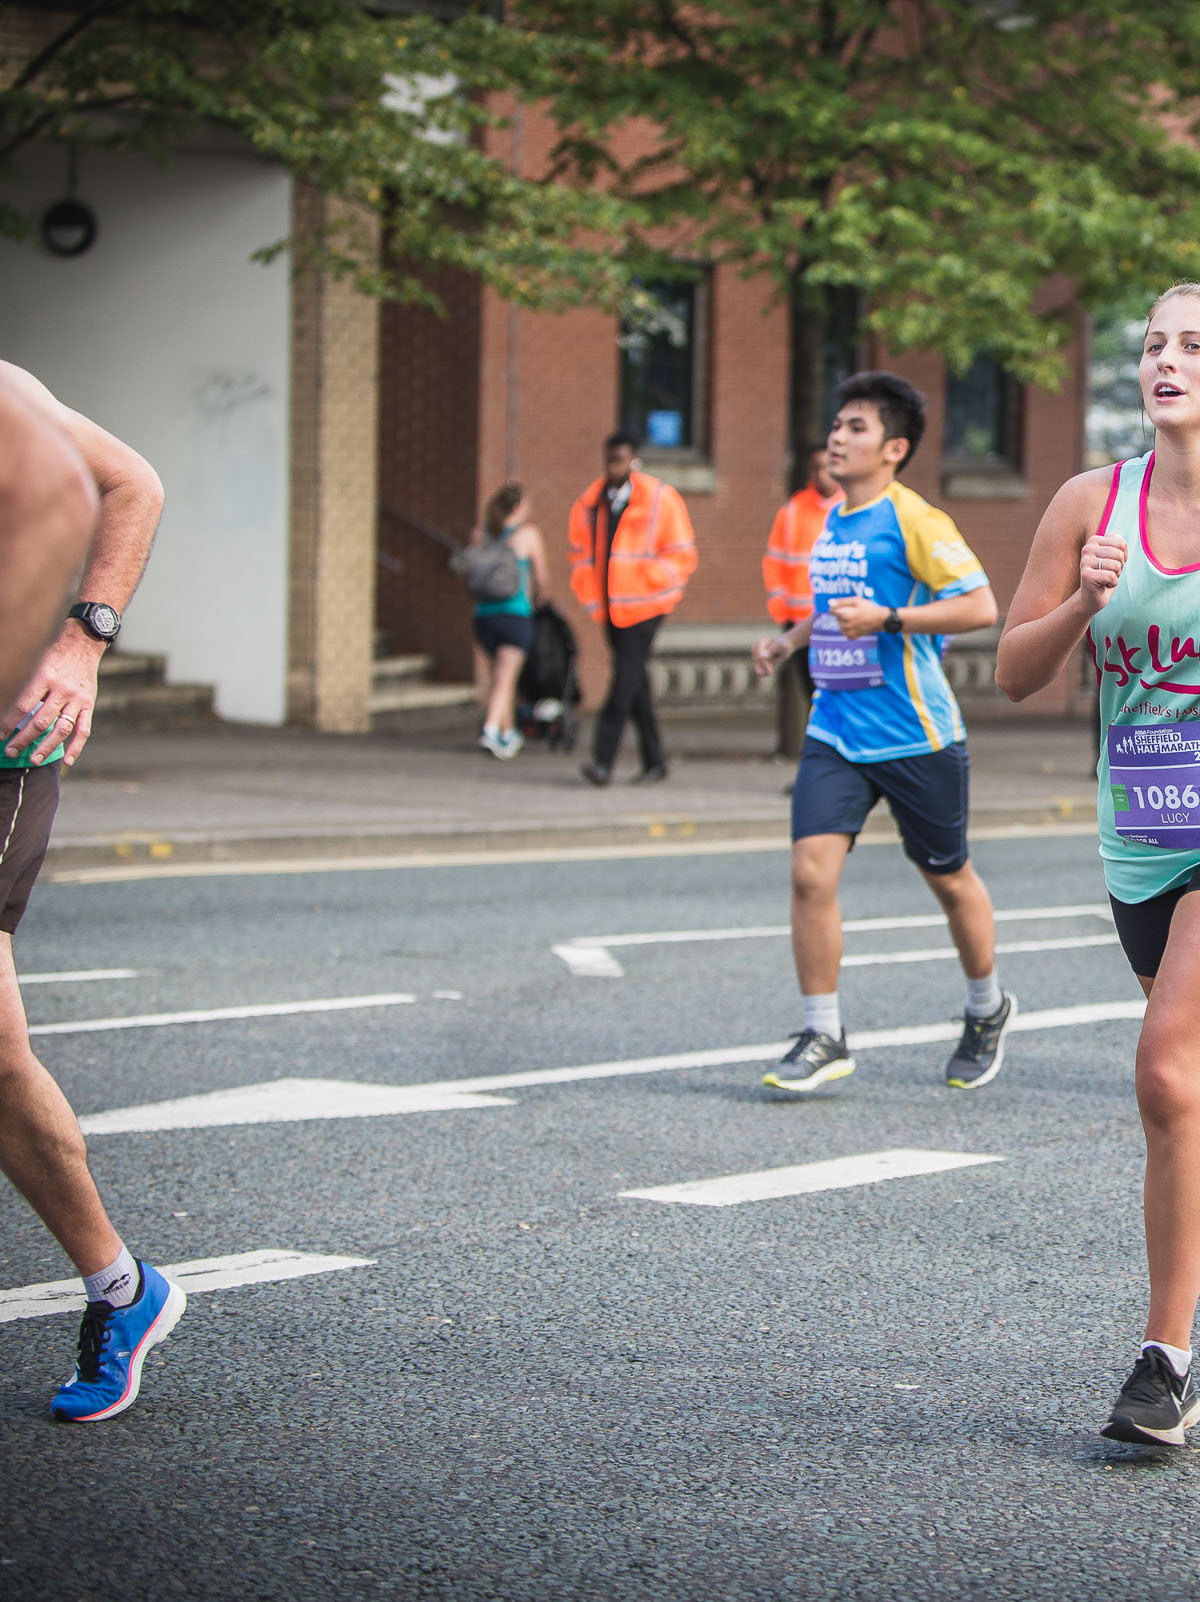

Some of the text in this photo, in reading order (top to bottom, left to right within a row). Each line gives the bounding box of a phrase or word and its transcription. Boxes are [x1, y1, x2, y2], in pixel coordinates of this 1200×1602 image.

[817, 648, 865, 668] 12363
[1103, 636, 1143, 687] St
[1135, 733, 1180, 745] SHEFFIELD
[1137, 745, 1160, 754] HALF
[1161, 812, 1190, 824] LUCY
